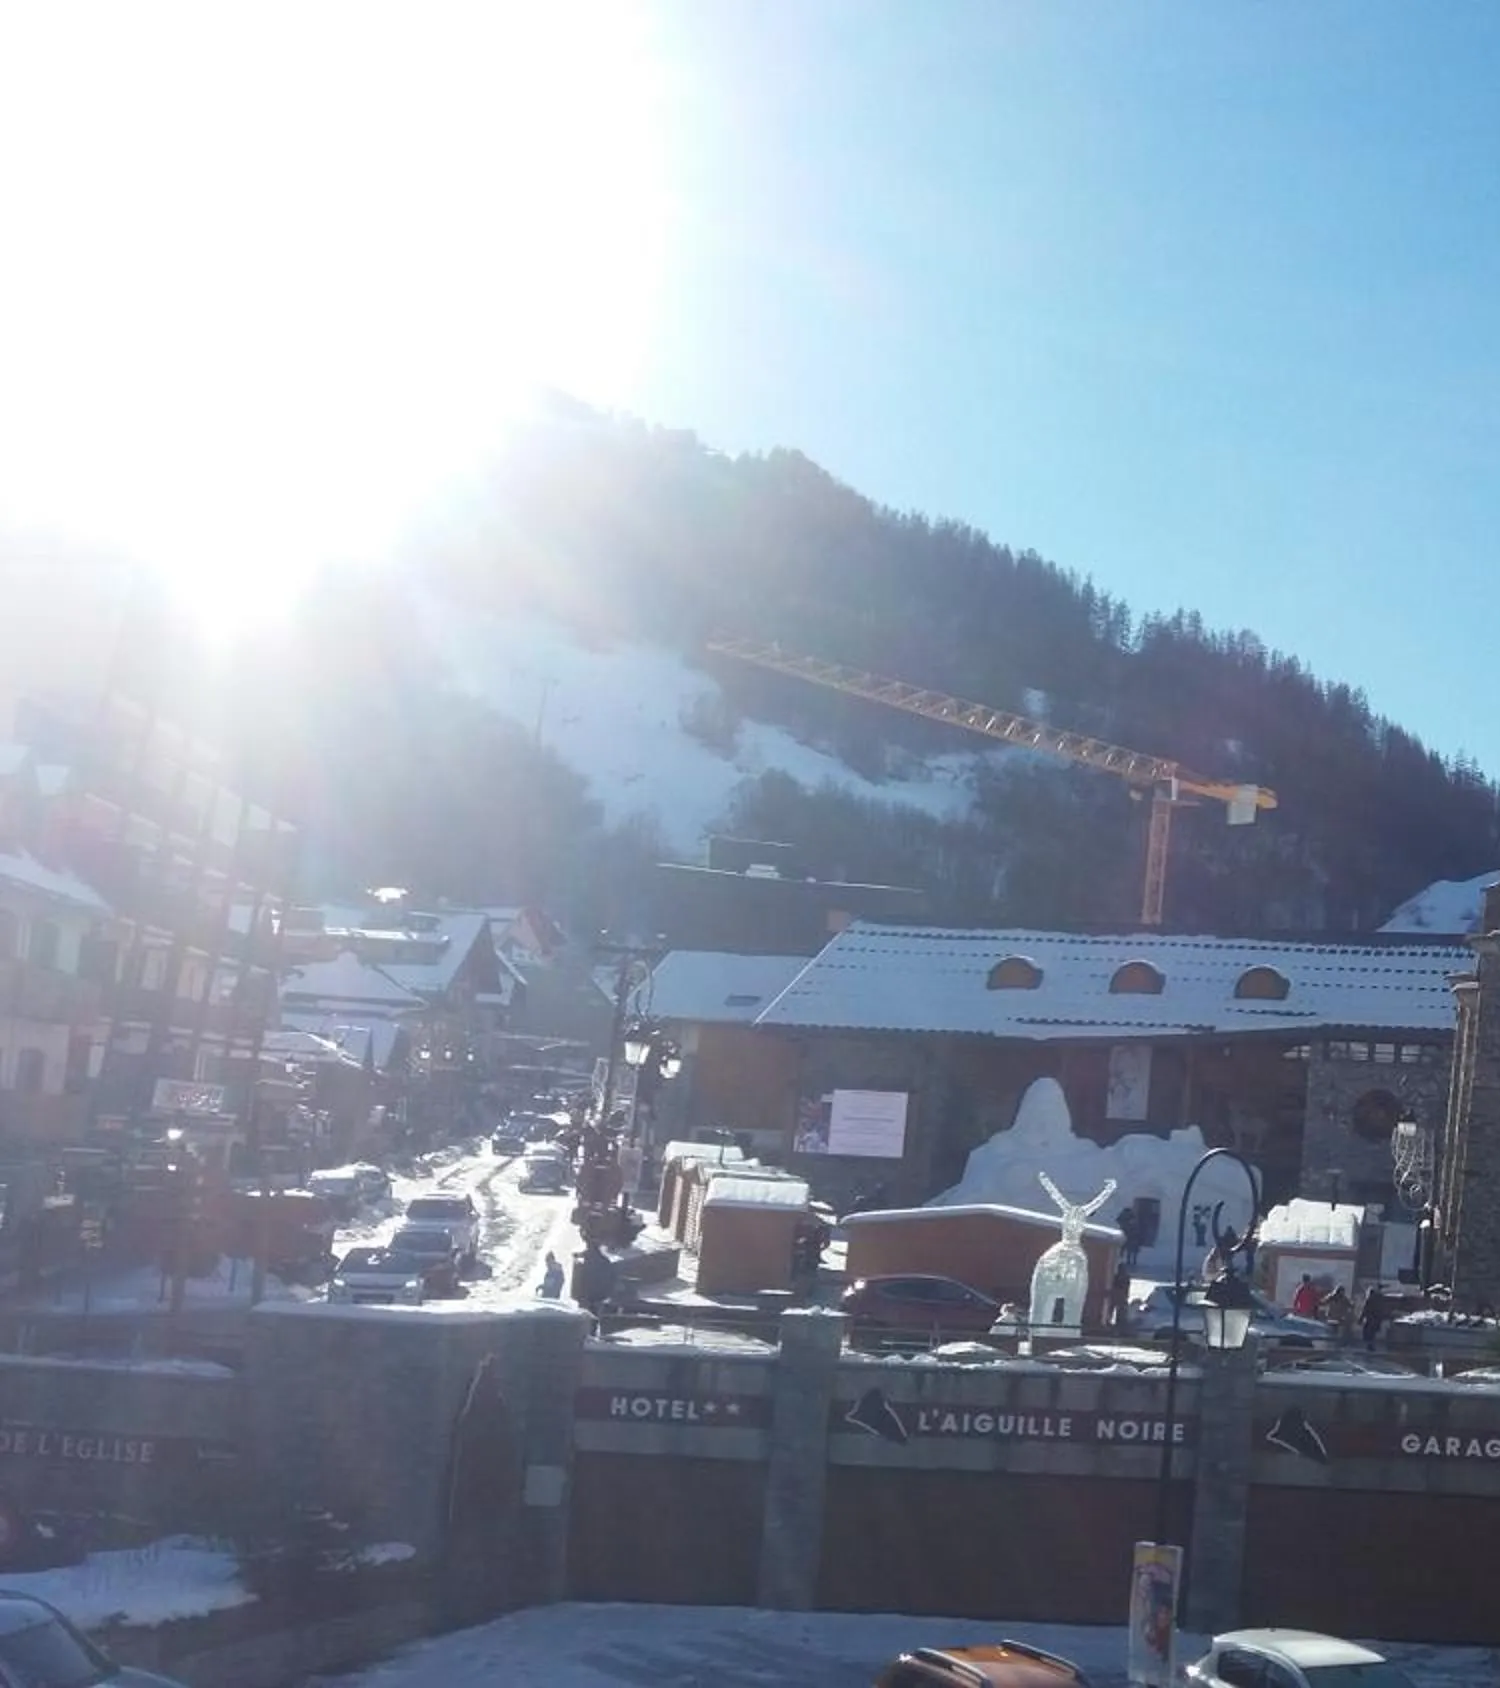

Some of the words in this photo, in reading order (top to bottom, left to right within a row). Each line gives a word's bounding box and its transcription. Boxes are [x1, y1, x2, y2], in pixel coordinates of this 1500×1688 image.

[610, 1396, 700, 1420] HOTEL
[918, 1408, 1073, 1437] L'AIGUILLE
[1096, 1418, 1186, 1442] NOIRE
[37, 1432, 155, 1463] L'EGLISE
